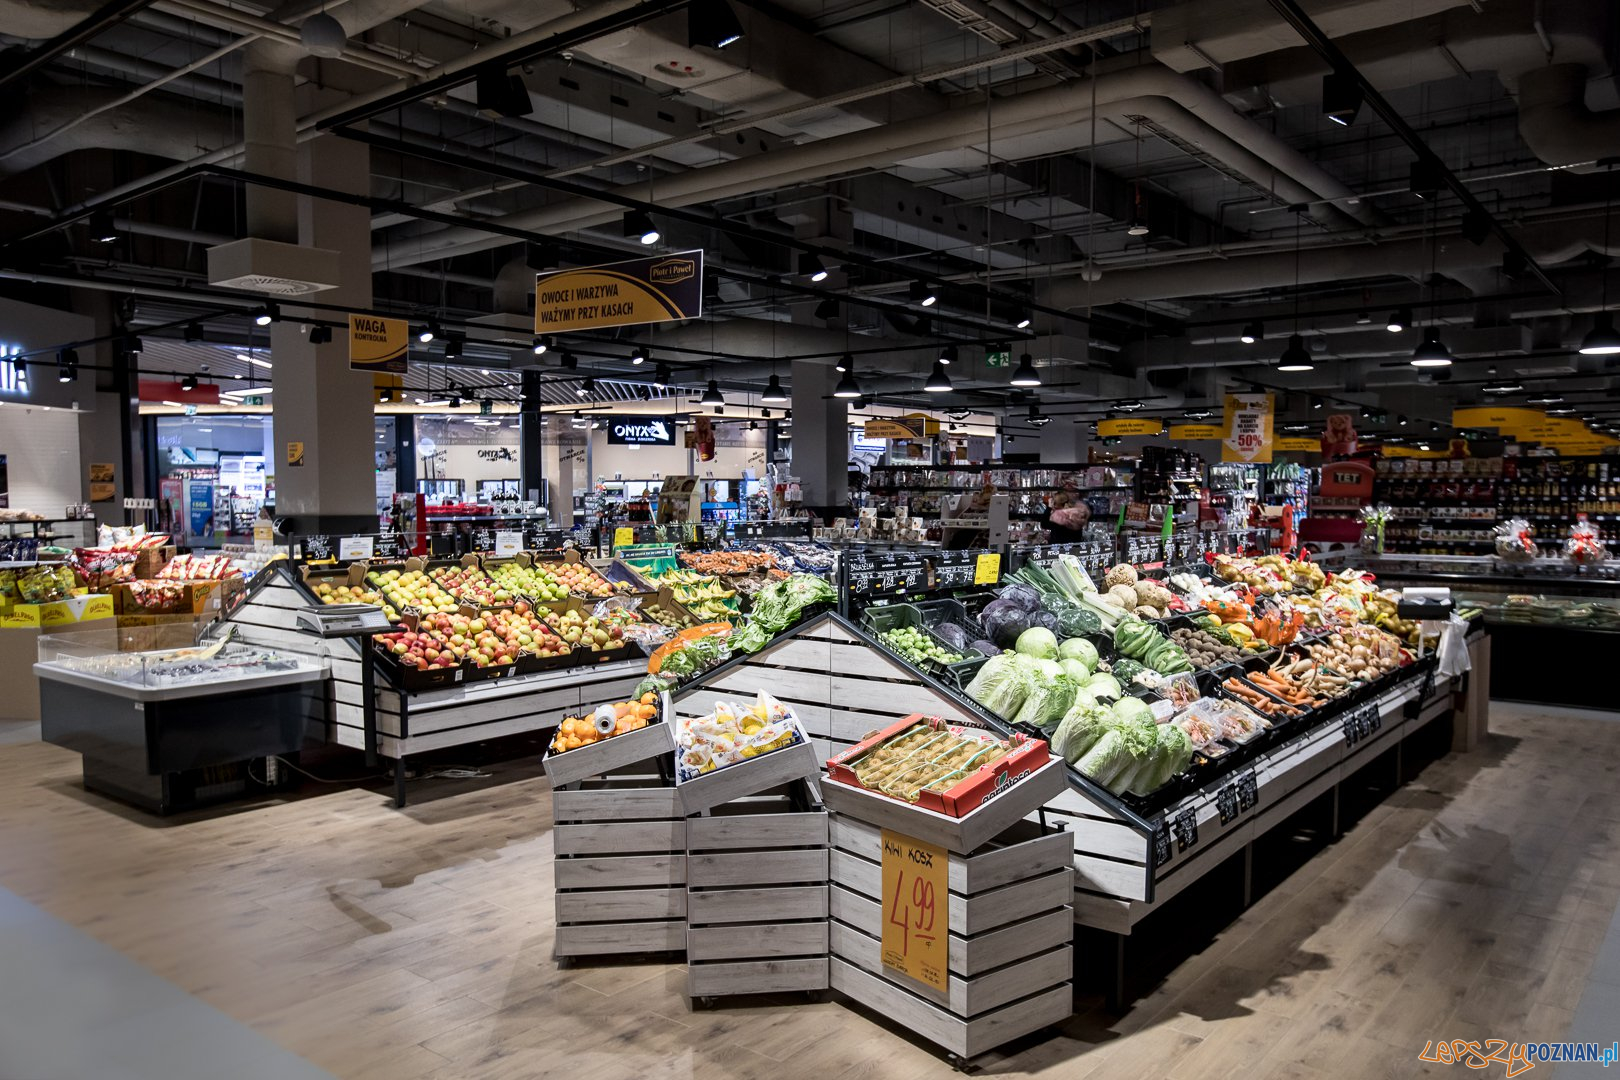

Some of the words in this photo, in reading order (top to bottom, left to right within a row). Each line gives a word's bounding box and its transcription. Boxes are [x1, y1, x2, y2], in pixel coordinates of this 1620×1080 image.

[541, 289, 569, 305] OWOCE
[571, 289, 574, 302] I
[576, 284, 619, 301] WARZYWA
[541, 306, 575, 323] WAŻYMY
[578, 306, 598, 320] PRZY
[601, 302, 634, 317] KASACH
[354, 318, 387, 334] WAGA
[354, 333, 388, 342] KONTROLNA
[614, 424, 649, 437] ONYX
[884, 839, 903, 859] KIWI
[907, 847, 933, 869] KOSZ
